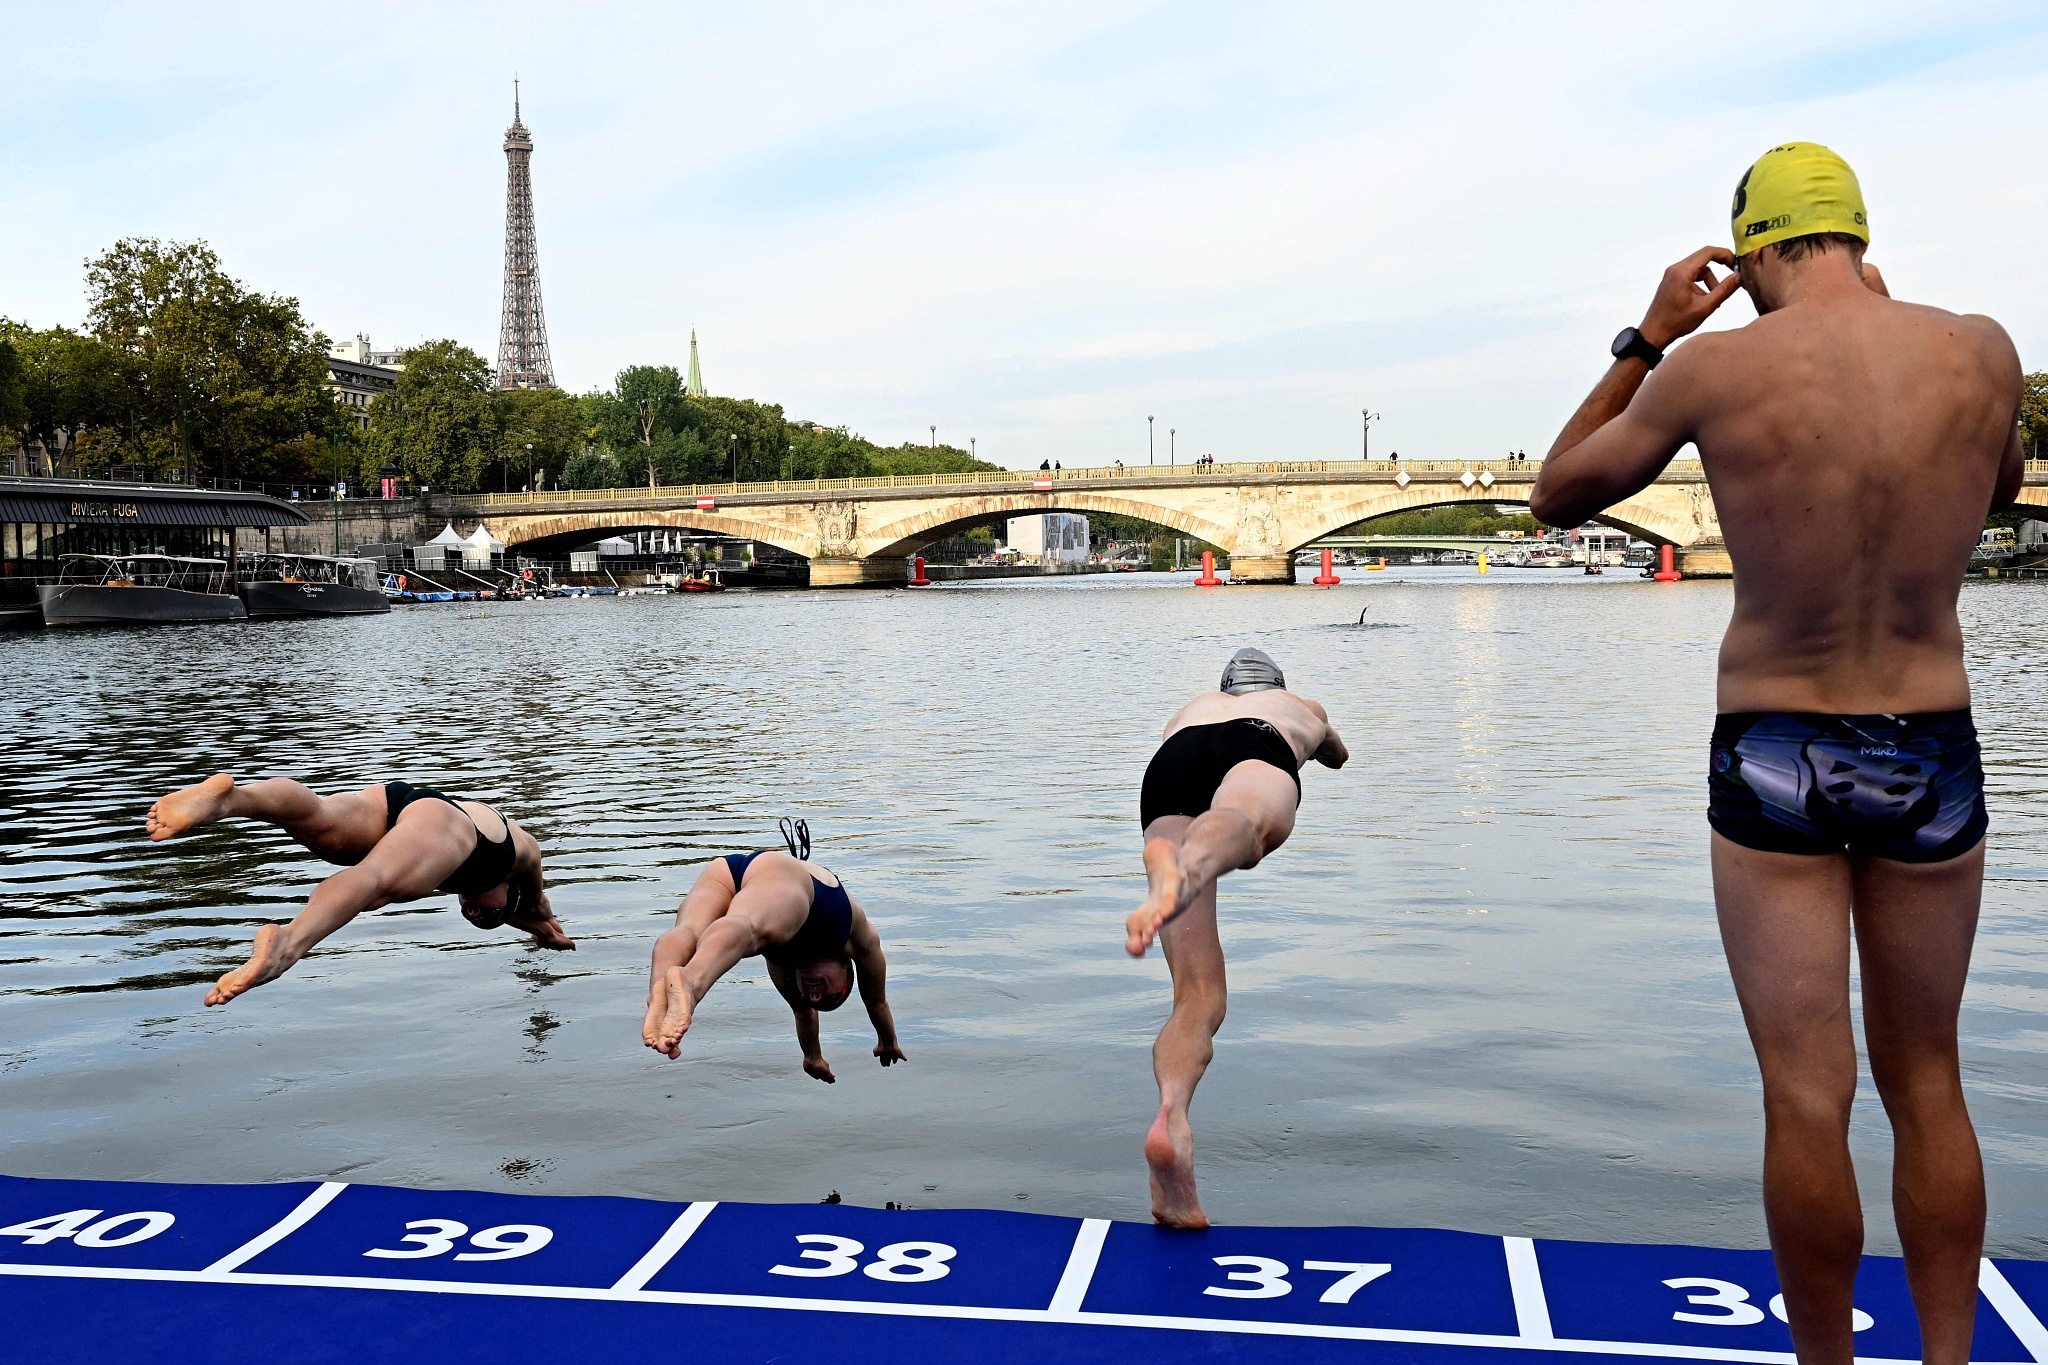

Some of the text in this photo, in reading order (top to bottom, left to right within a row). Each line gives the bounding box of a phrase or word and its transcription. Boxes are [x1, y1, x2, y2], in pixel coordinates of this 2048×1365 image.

[71, 502, 138, 517] RIVIERA FUGA
[1860, 746, 1898, 756] MAKO
[0, 1210, 175, 1248] 40
[362, 1219, 553, 1262] 39
[768, 1234, 957, 1283] 38
[1203, 1256, 1391, 1304] 37
